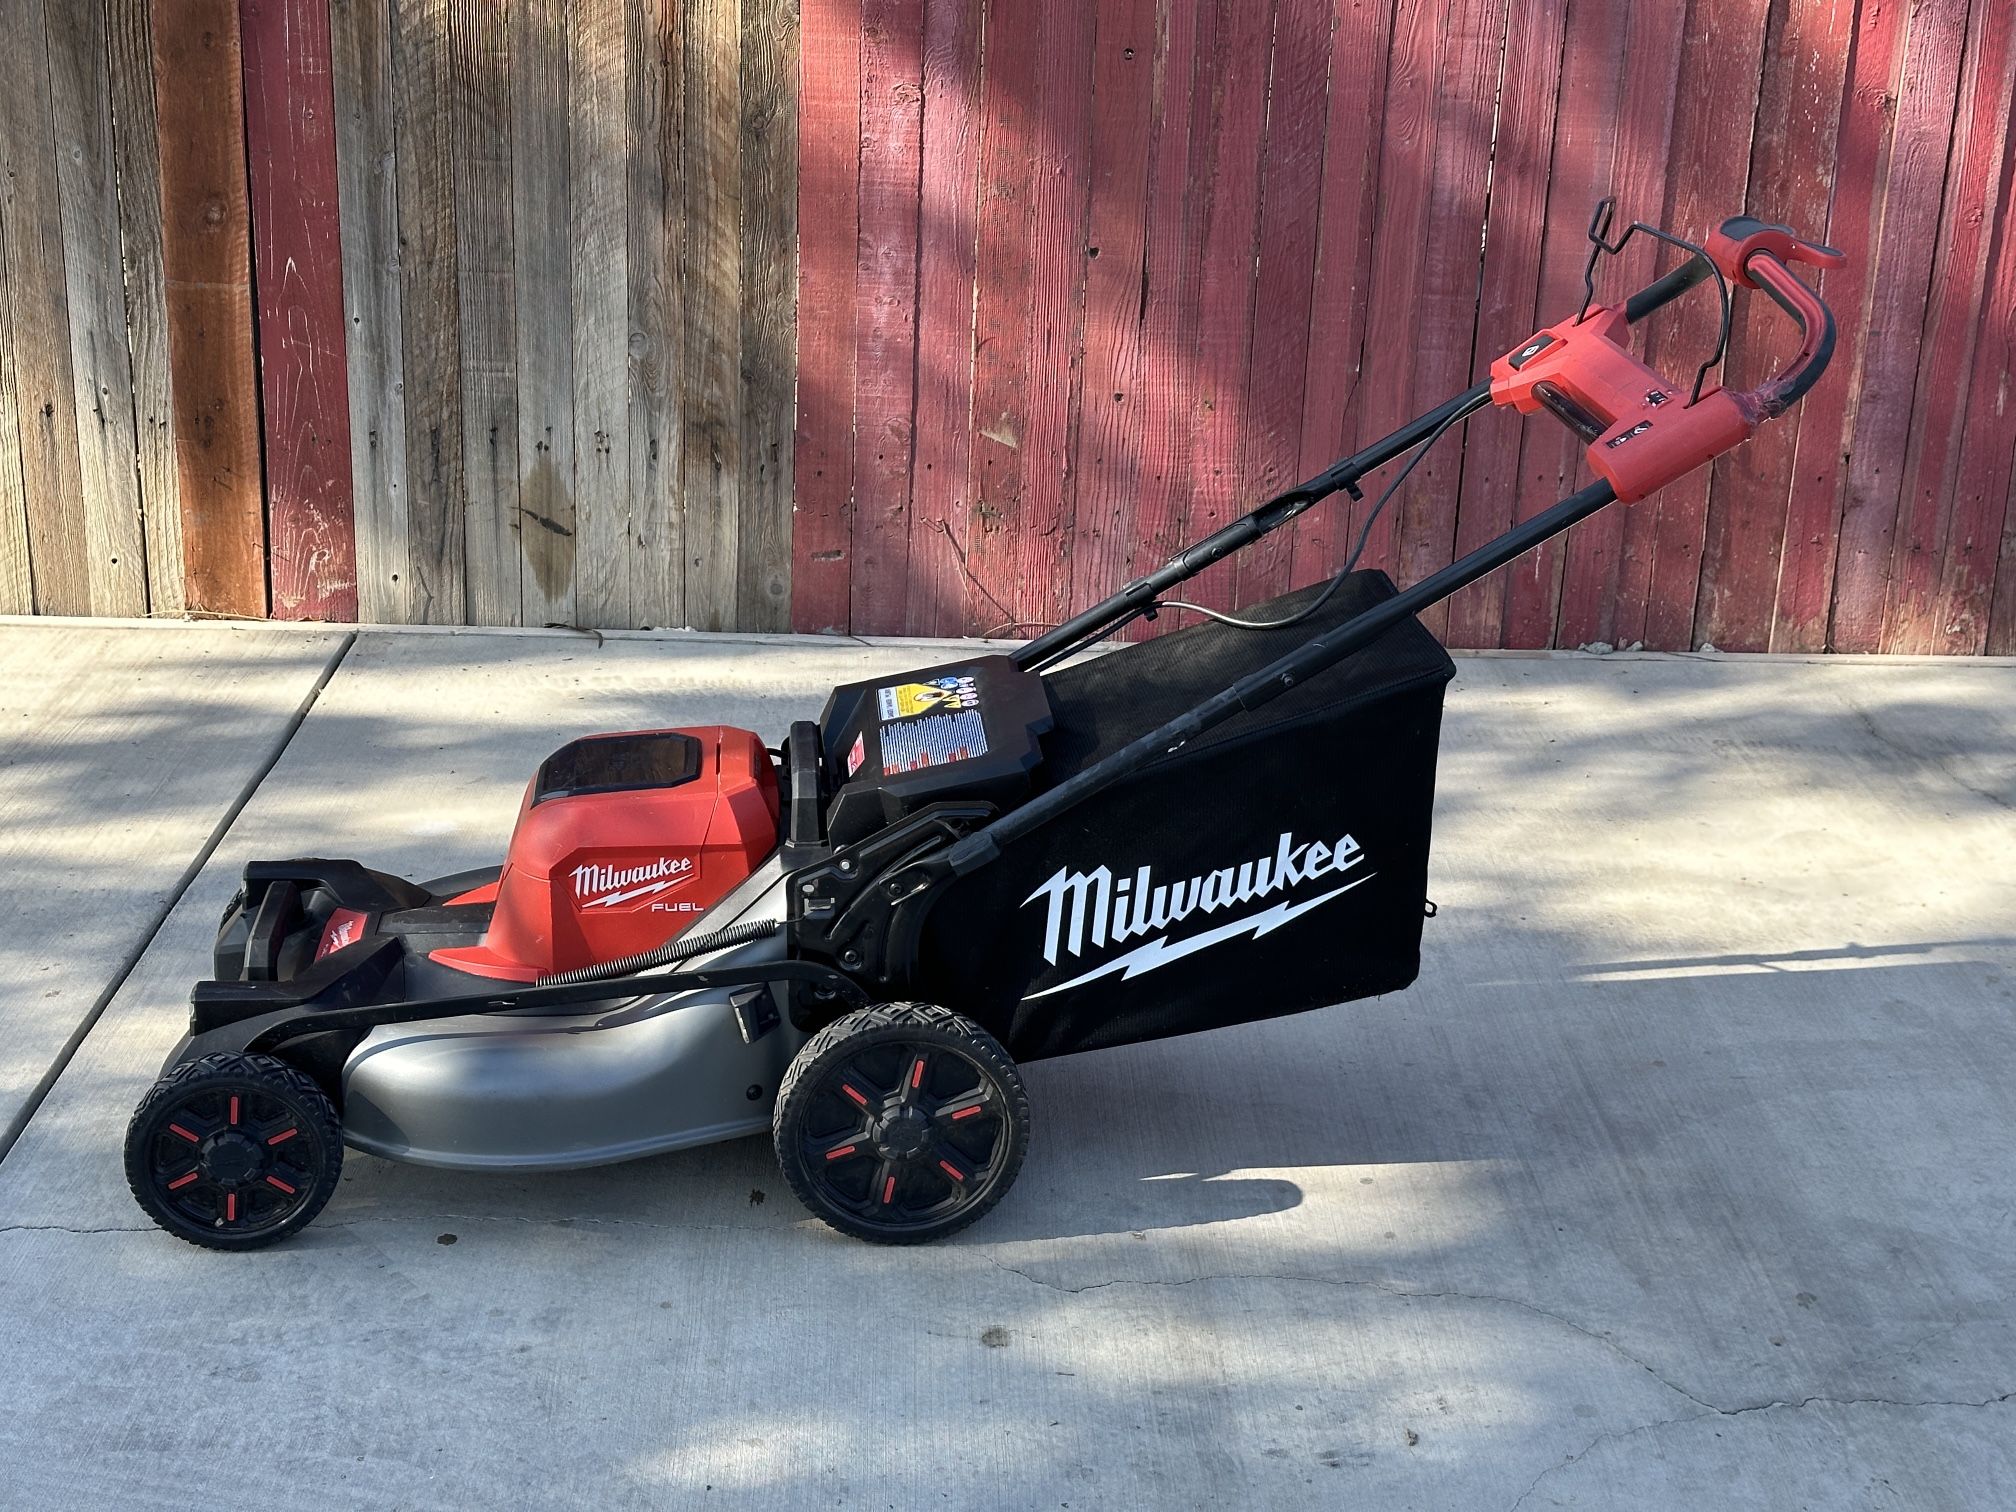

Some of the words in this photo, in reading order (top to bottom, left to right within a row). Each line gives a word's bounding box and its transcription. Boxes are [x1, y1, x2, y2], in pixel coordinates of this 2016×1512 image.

[569, 857, 693, 900] Milwaukee
[1019, 832, 1365, 966] Milwaukee
[651, 902, 704, 912] FUEL
